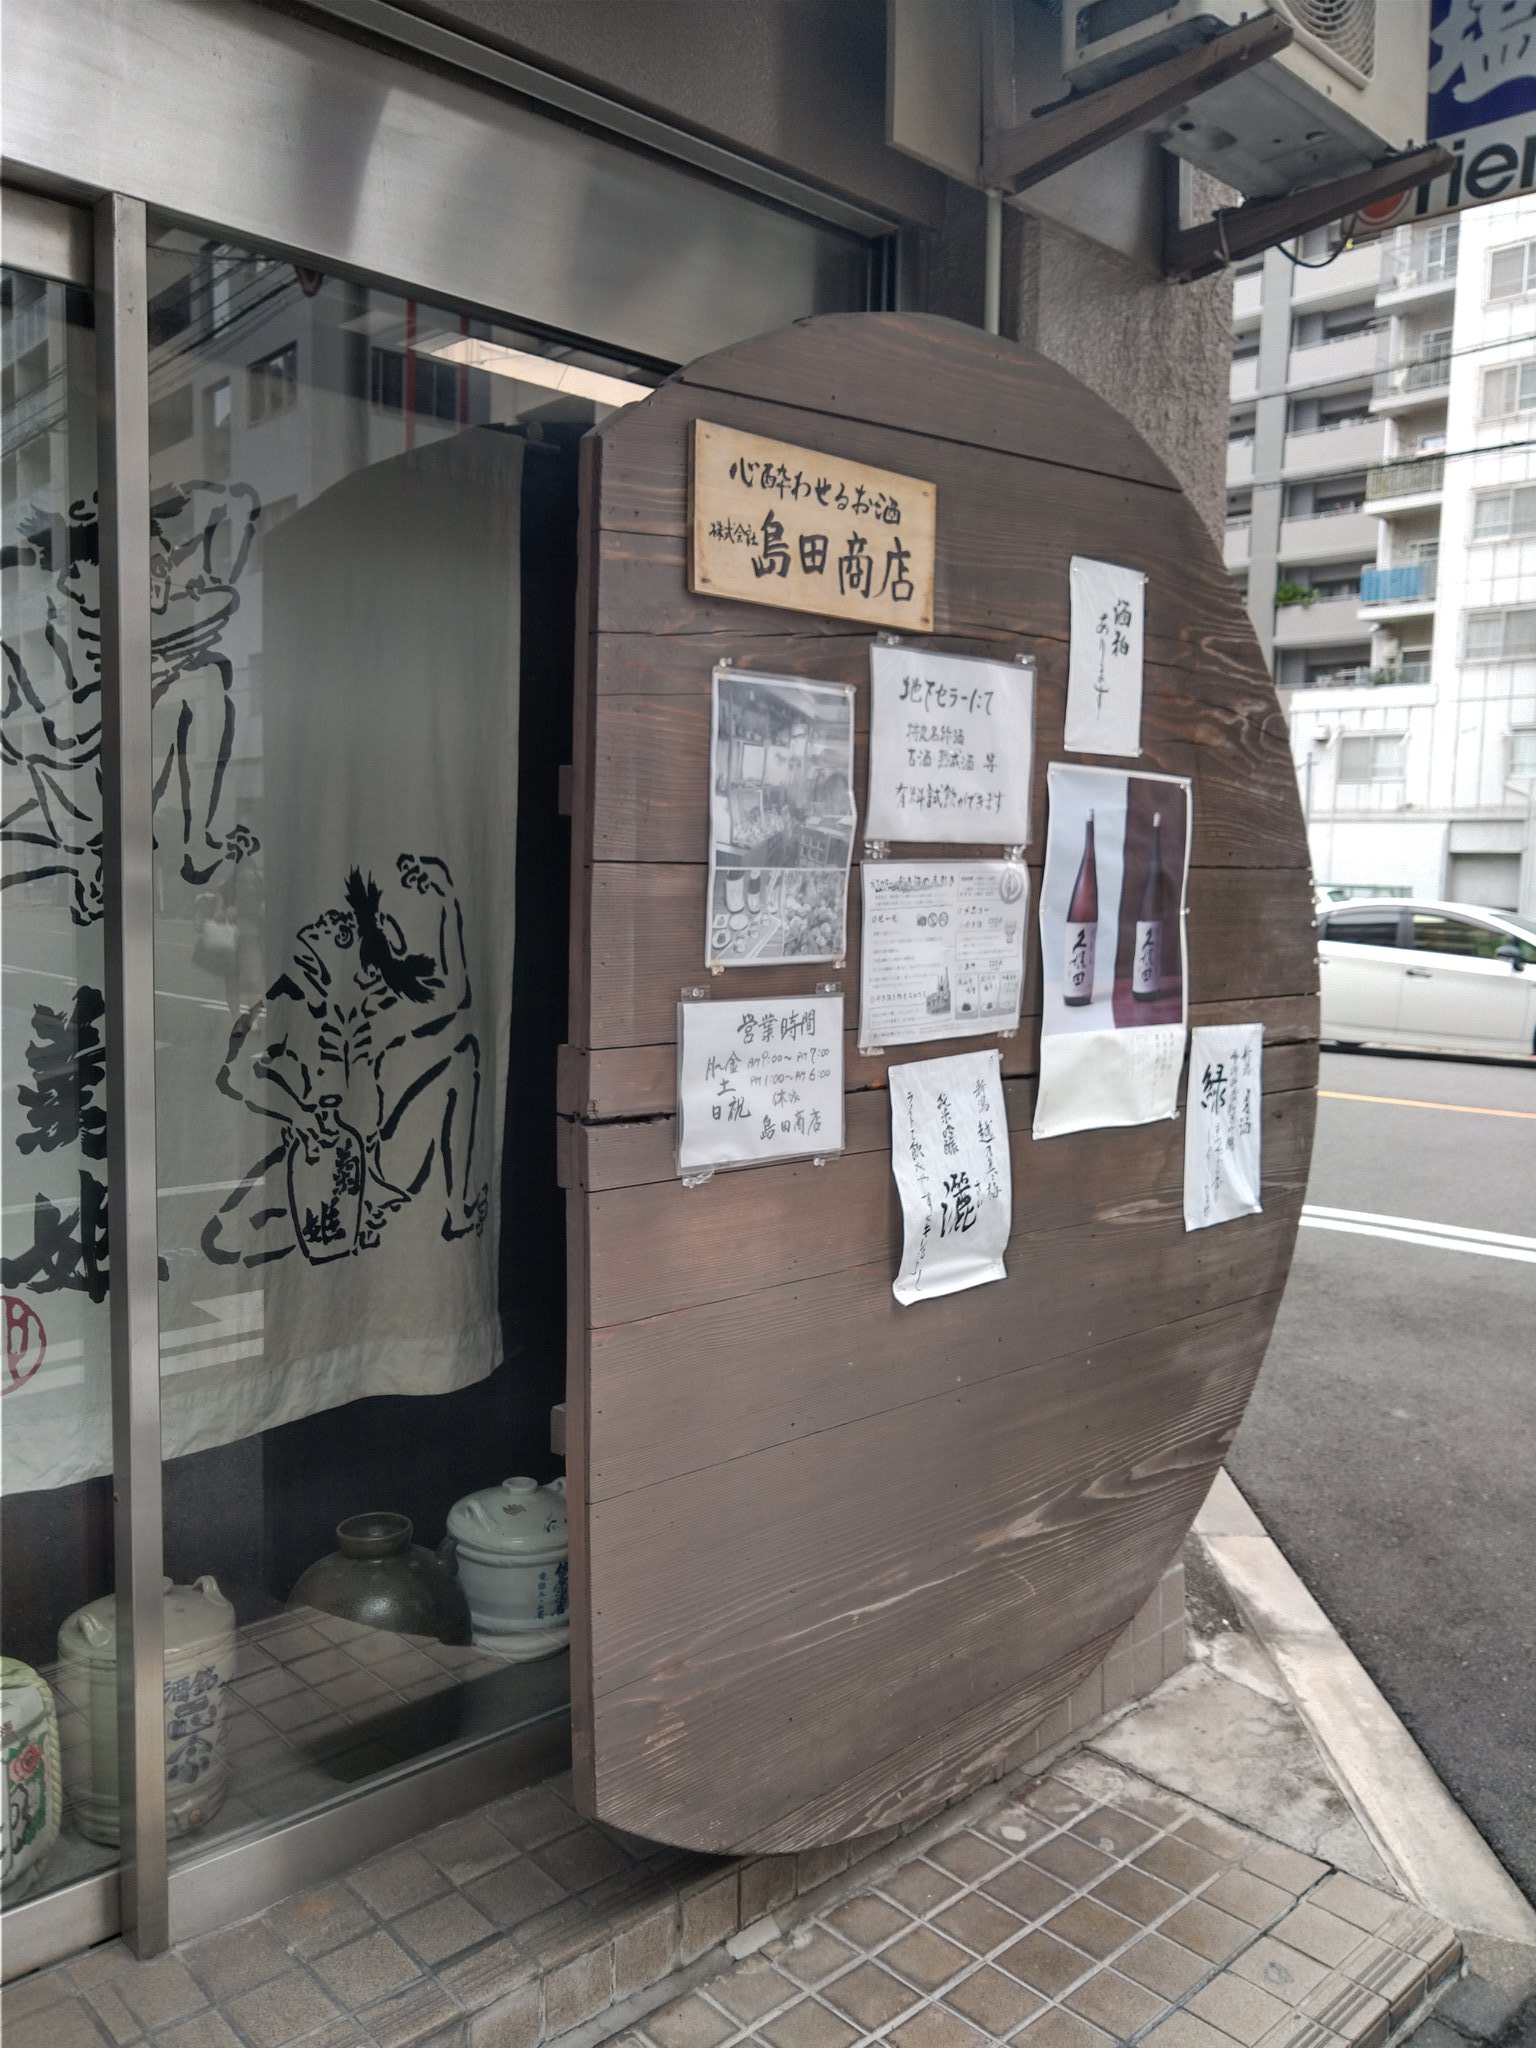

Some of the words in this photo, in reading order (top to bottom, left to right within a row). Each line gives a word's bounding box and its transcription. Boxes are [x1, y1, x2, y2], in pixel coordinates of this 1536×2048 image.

[729, 457, 901, 525] 心酔わせるお酒
[708, 517, 759, 547] 株式会社
[751, 509, 914, 602] 島田商店
[899, 676, 995, 716] 地下セラーにて
[907, 748, 932, 768] 古酒
[1069, 928, 1087, 987] 久保田
[1140, 927, 1154, 983] 久保田
[737, 1008, 816, 1044] 営業時間
[717, 1080, 737, 1097] 土
[760, 1108, 822, 1141] 島田商店
